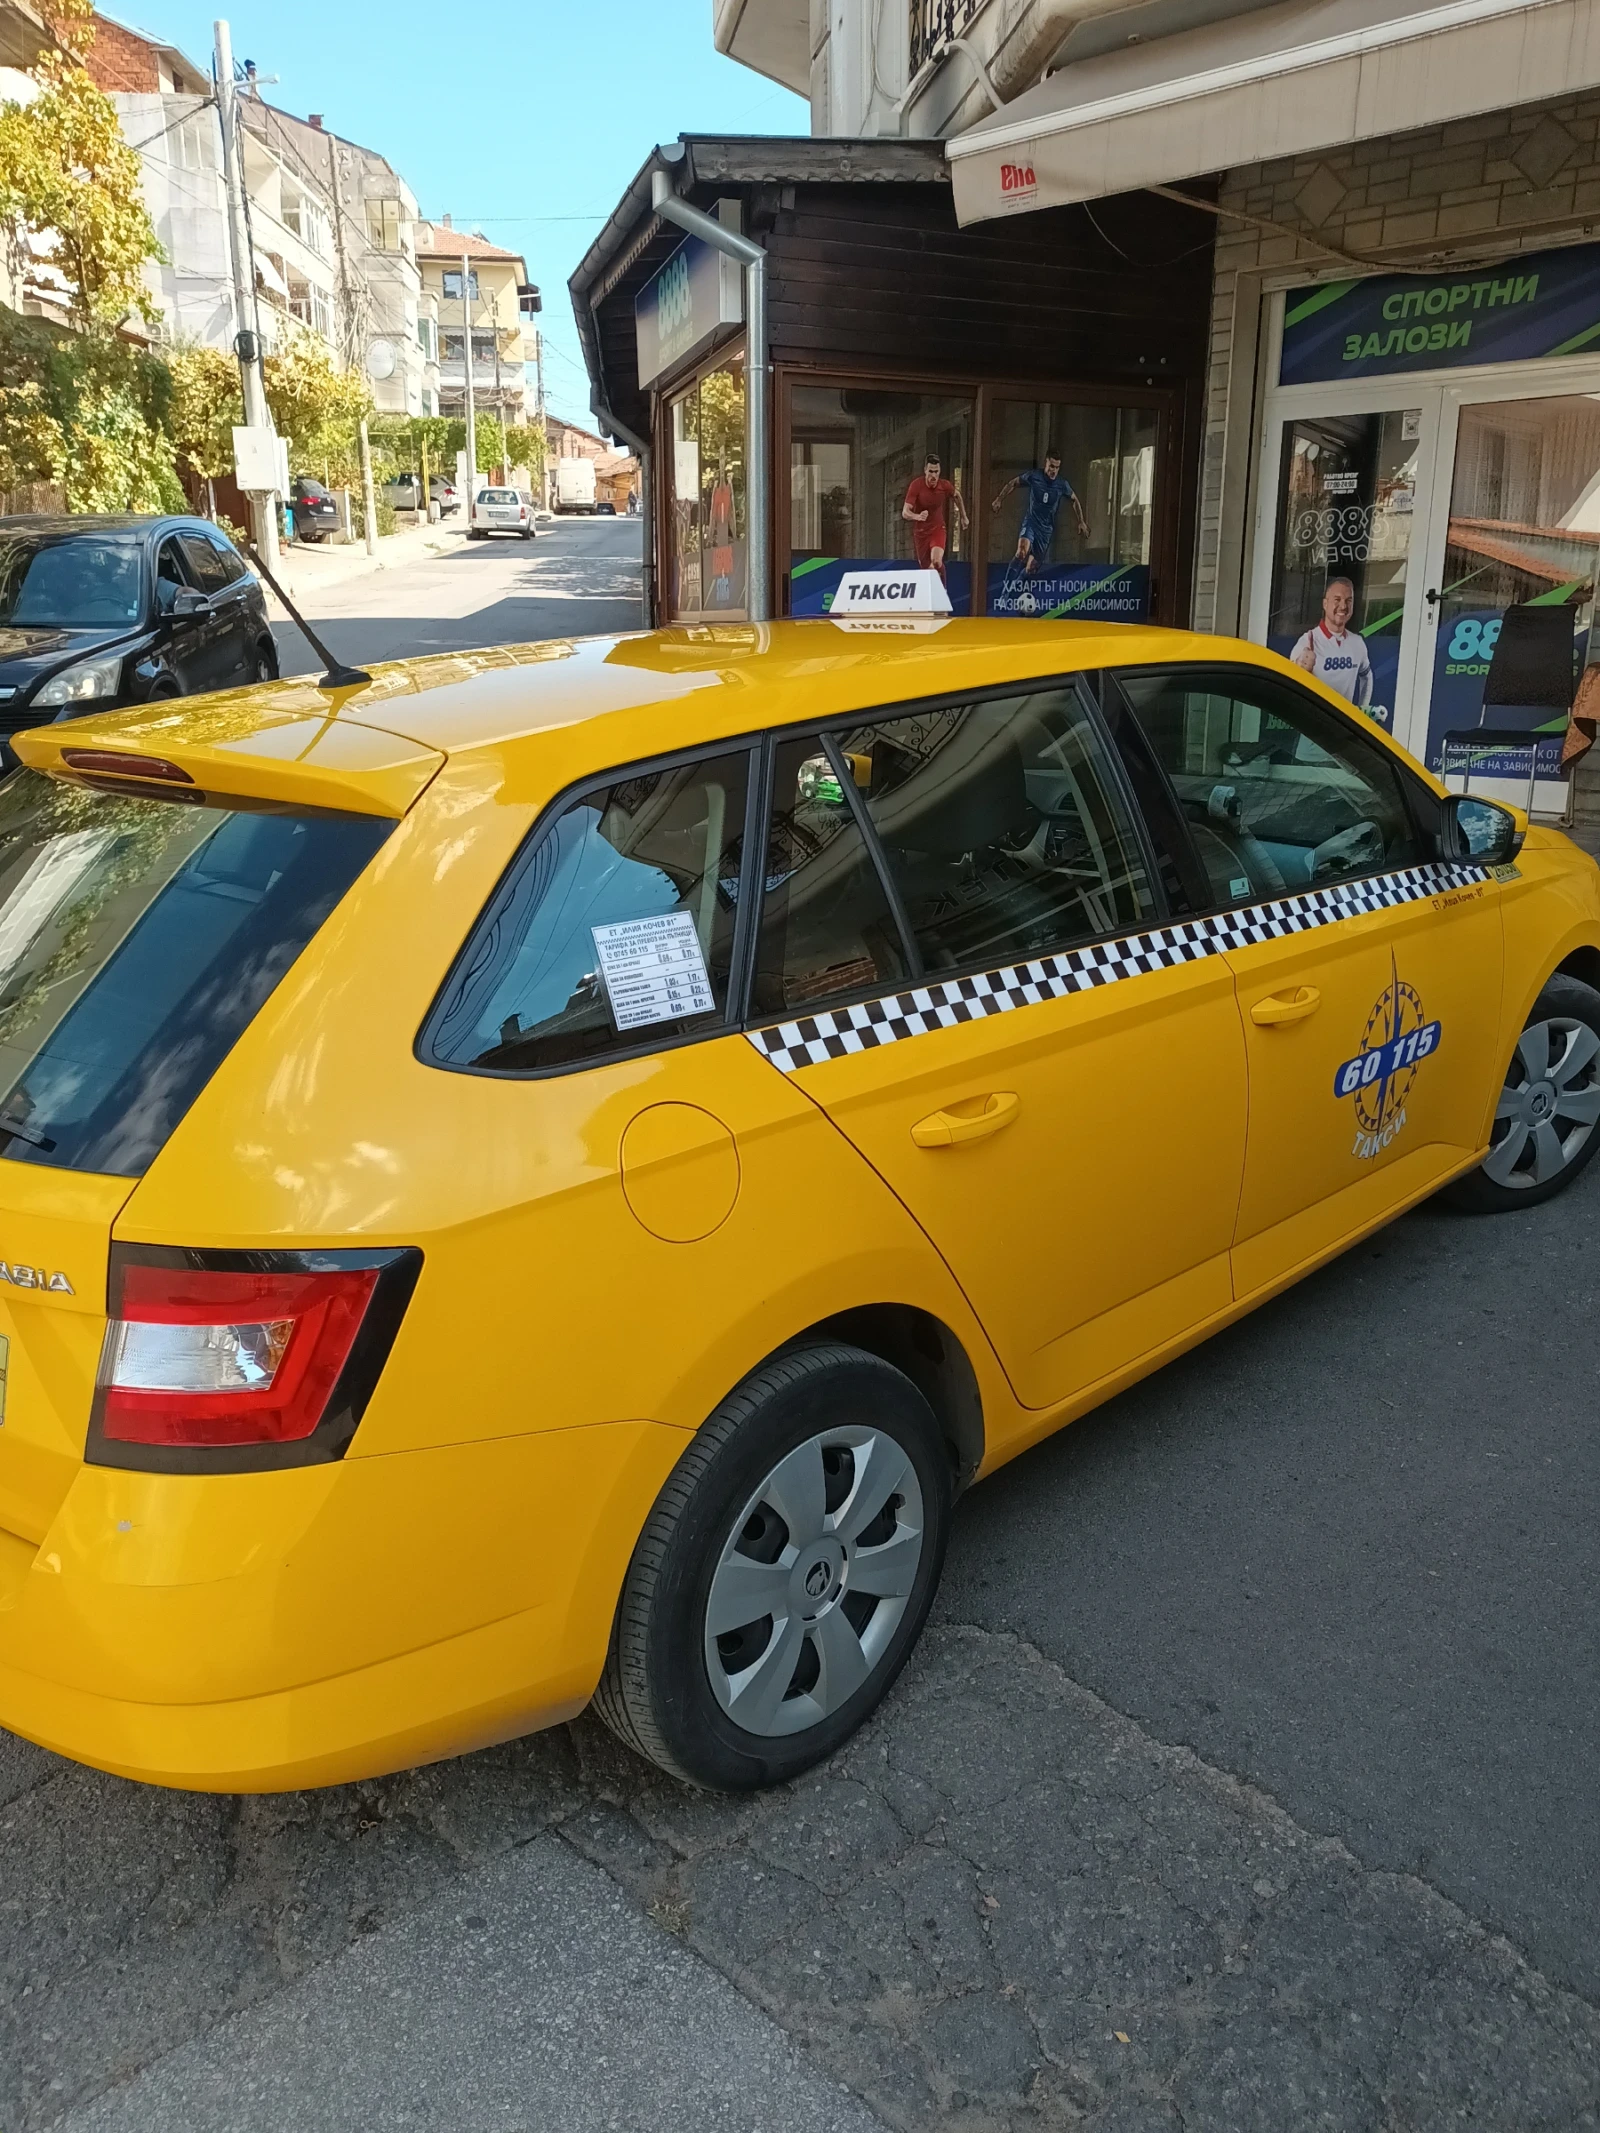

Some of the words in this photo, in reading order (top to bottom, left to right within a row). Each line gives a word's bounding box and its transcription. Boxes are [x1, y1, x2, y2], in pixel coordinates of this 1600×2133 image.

[1382, 274, 1540, 321] СПОРТНИ
[1342, 320, 1473, 361] ЗАЛОЗИ
[849, 582, 917, 600] ТАКСИ
[1002, 580, 1057, 593] ХАЗАРТЪТ
[1059, 580, 1087, 593] НОСИ
[1090, 580, 1116, 593] РИСК
[1118, 580, 1132, 592] ОТ
[1057, 599, 1071, 611] НА
[1073, 599, 1141, 611] ЗАВИСИМОСТ
[1445, 664, 1490, 676] SPOR
[1546, 749, 1560, 760] ОТ
[1487, 761, 1501, 771] НА
[609, 929, 617, 937] ЕТ
[643, 920, 666, 931] КОЧЕВ
[638, 945, 649, 953] 115
[1341, 1050, 1382, 1093] 60
[1391, 1023, 1436, 1070] 115
[1352, 1107, 1408, 1160] ТАКСИ
[0, 1261, 75, 1295] ABIA
